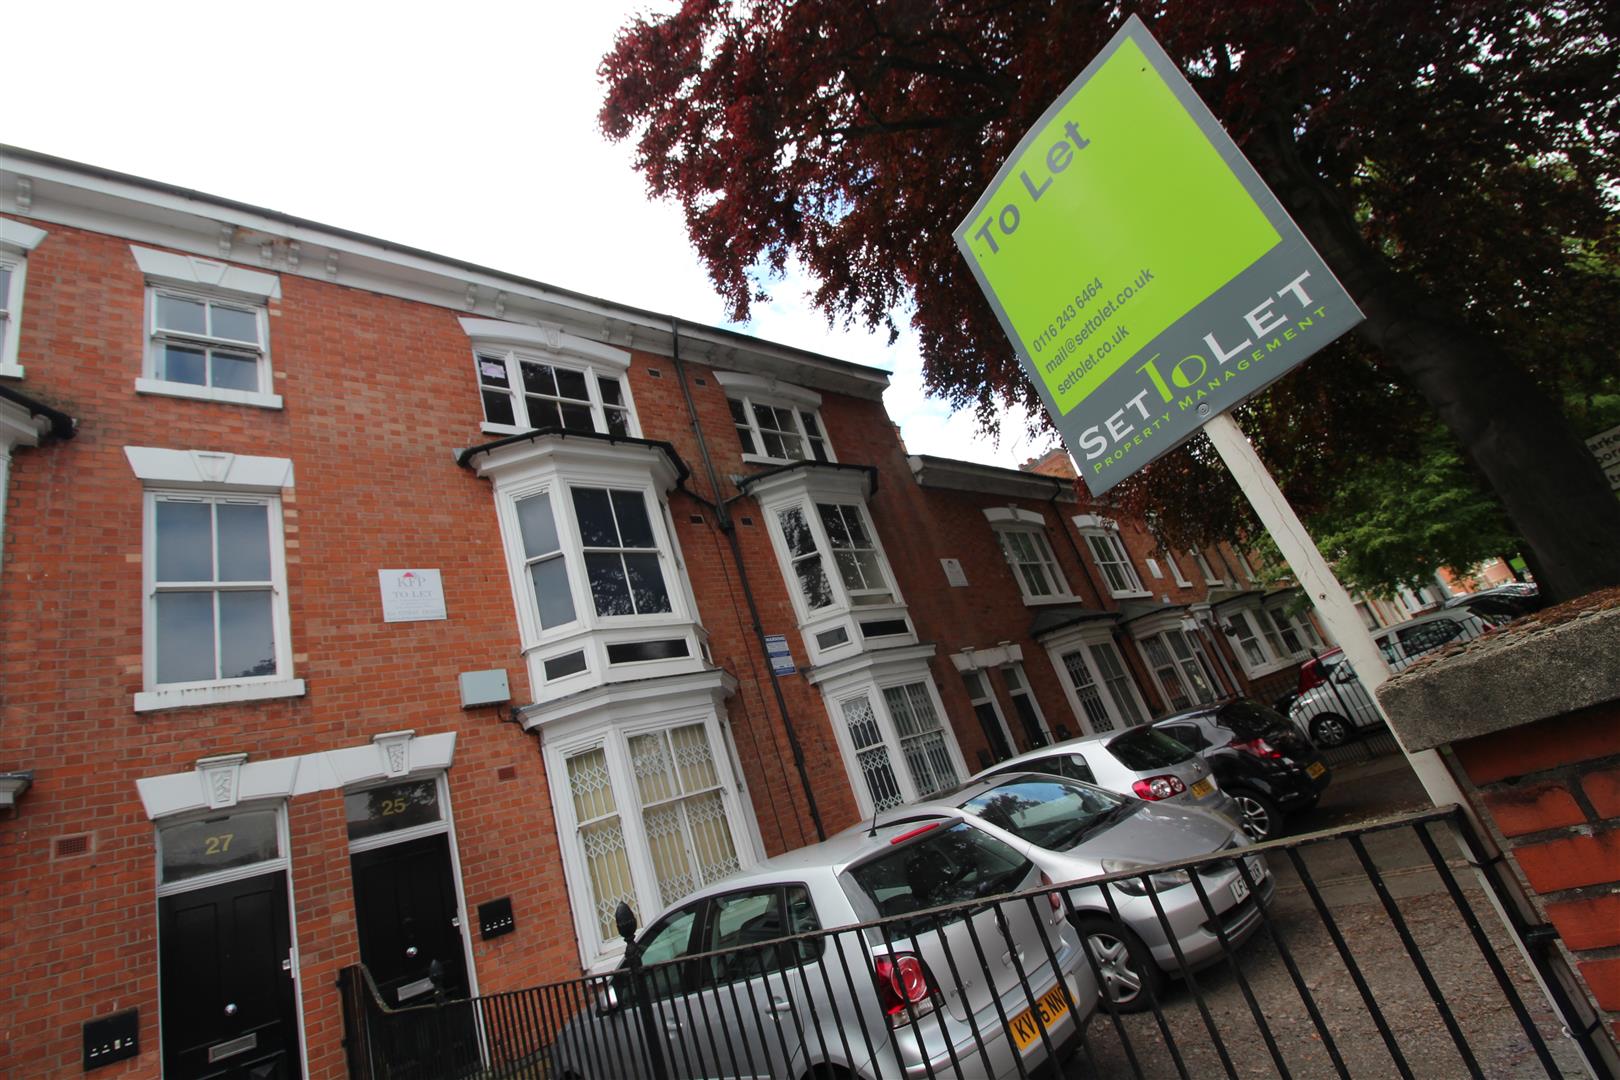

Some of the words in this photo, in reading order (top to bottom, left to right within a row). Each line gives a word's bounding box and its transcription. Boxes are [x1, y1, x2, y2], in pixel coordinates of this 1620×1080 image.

[974, 203, 1021, 255] To
[1019, 119, 1091, 203] Let
[1032, 324, 1058, 353] 0116
[1056, 304, 1077, 330] 243
[1075, 277, 1103, 309] 6464
[1045, 269, 1155, 374] mail@settolet.co.uk
[1058, 325, 1131, 395] settolet.co.uk
[1078, 388, 1151, 461] SET
[1203, 269, 1313, 366] LET
[1093, 412, 1172, 474] PROPERTY
[1177, 306, 1327, 412] MANAGEMENT
[205, 833, 234, 856] 27
[381, 799, 407, 817] 25
[1013, 1002, 1051, 1044] KV6
